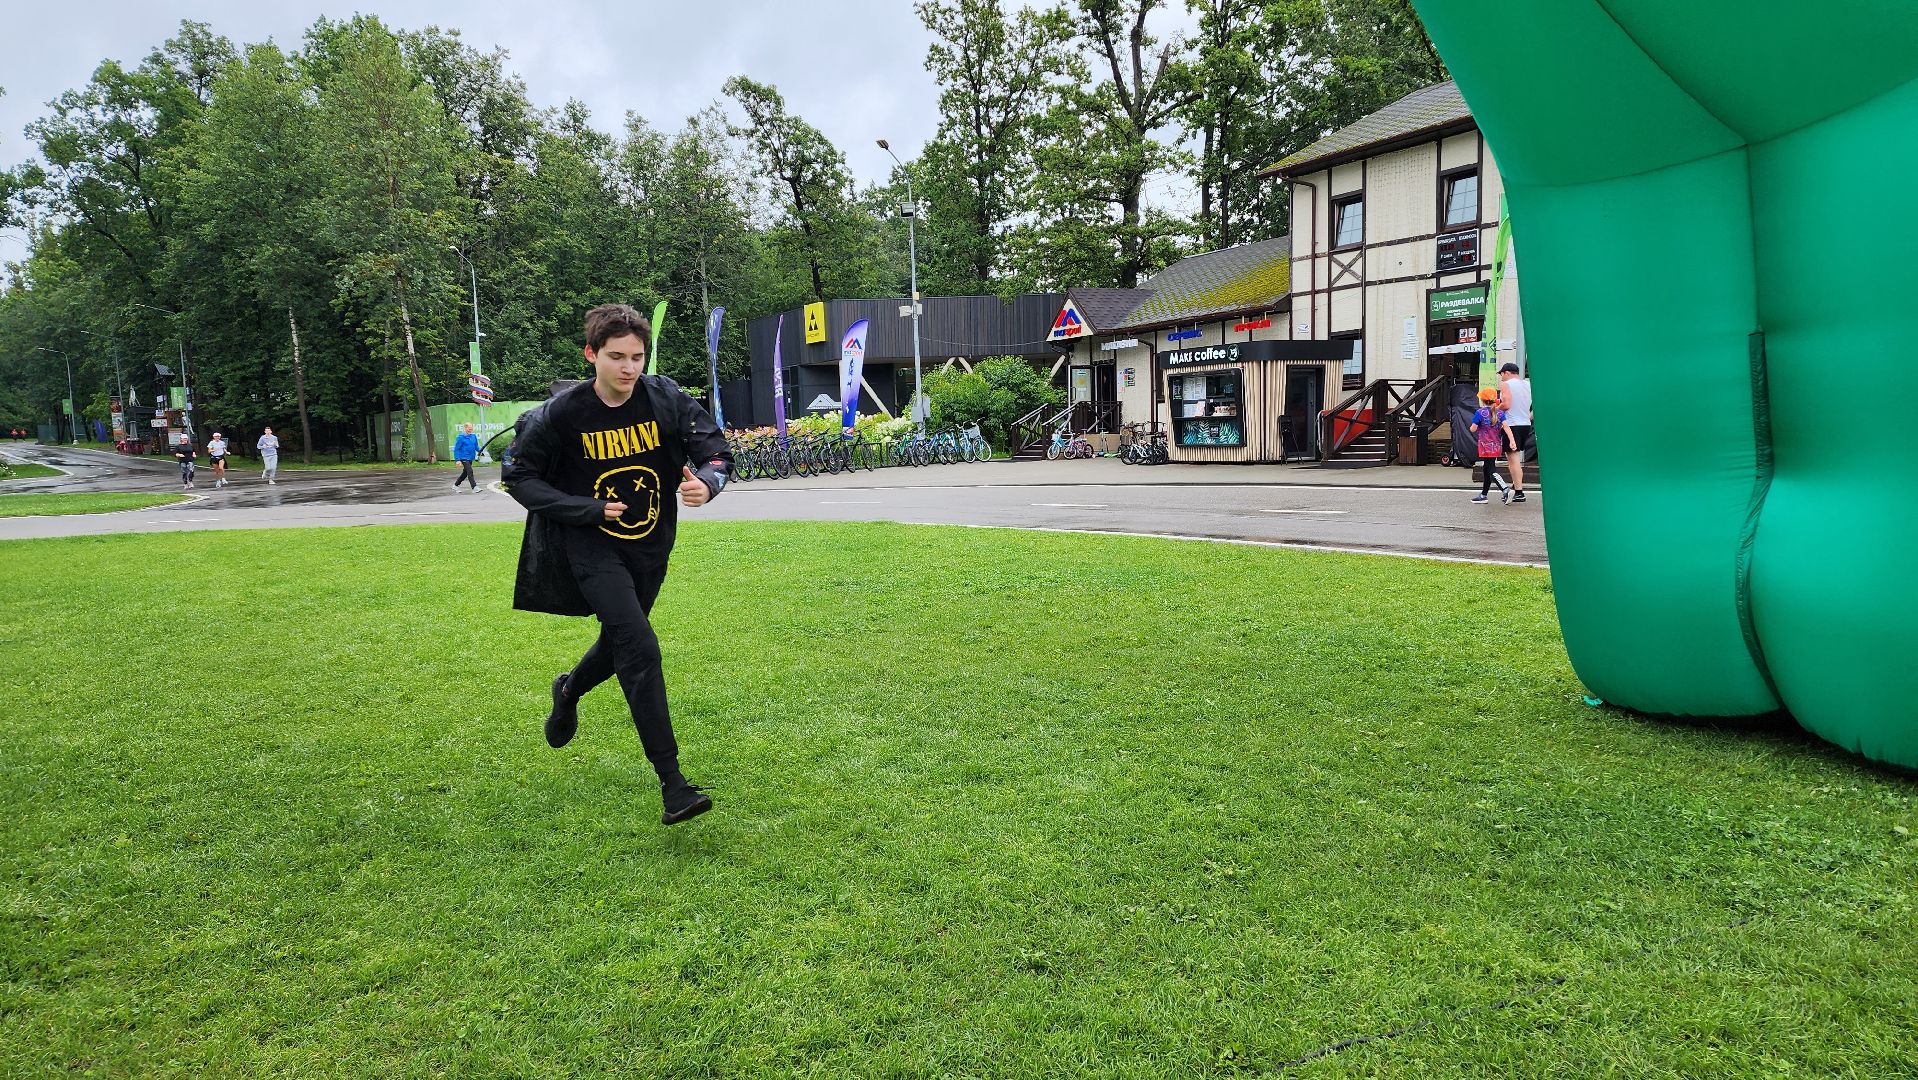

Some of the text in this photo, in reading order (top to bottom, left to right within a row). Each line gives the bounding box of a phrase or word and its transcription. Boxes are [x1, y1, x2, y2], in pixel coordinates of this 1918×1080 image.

[1440, 296, 1485, 308] РАЗДЕВАЛКА
[1194, 347, 1227, 362] coffee
[580, 420, 661, 460] NIRVANA
